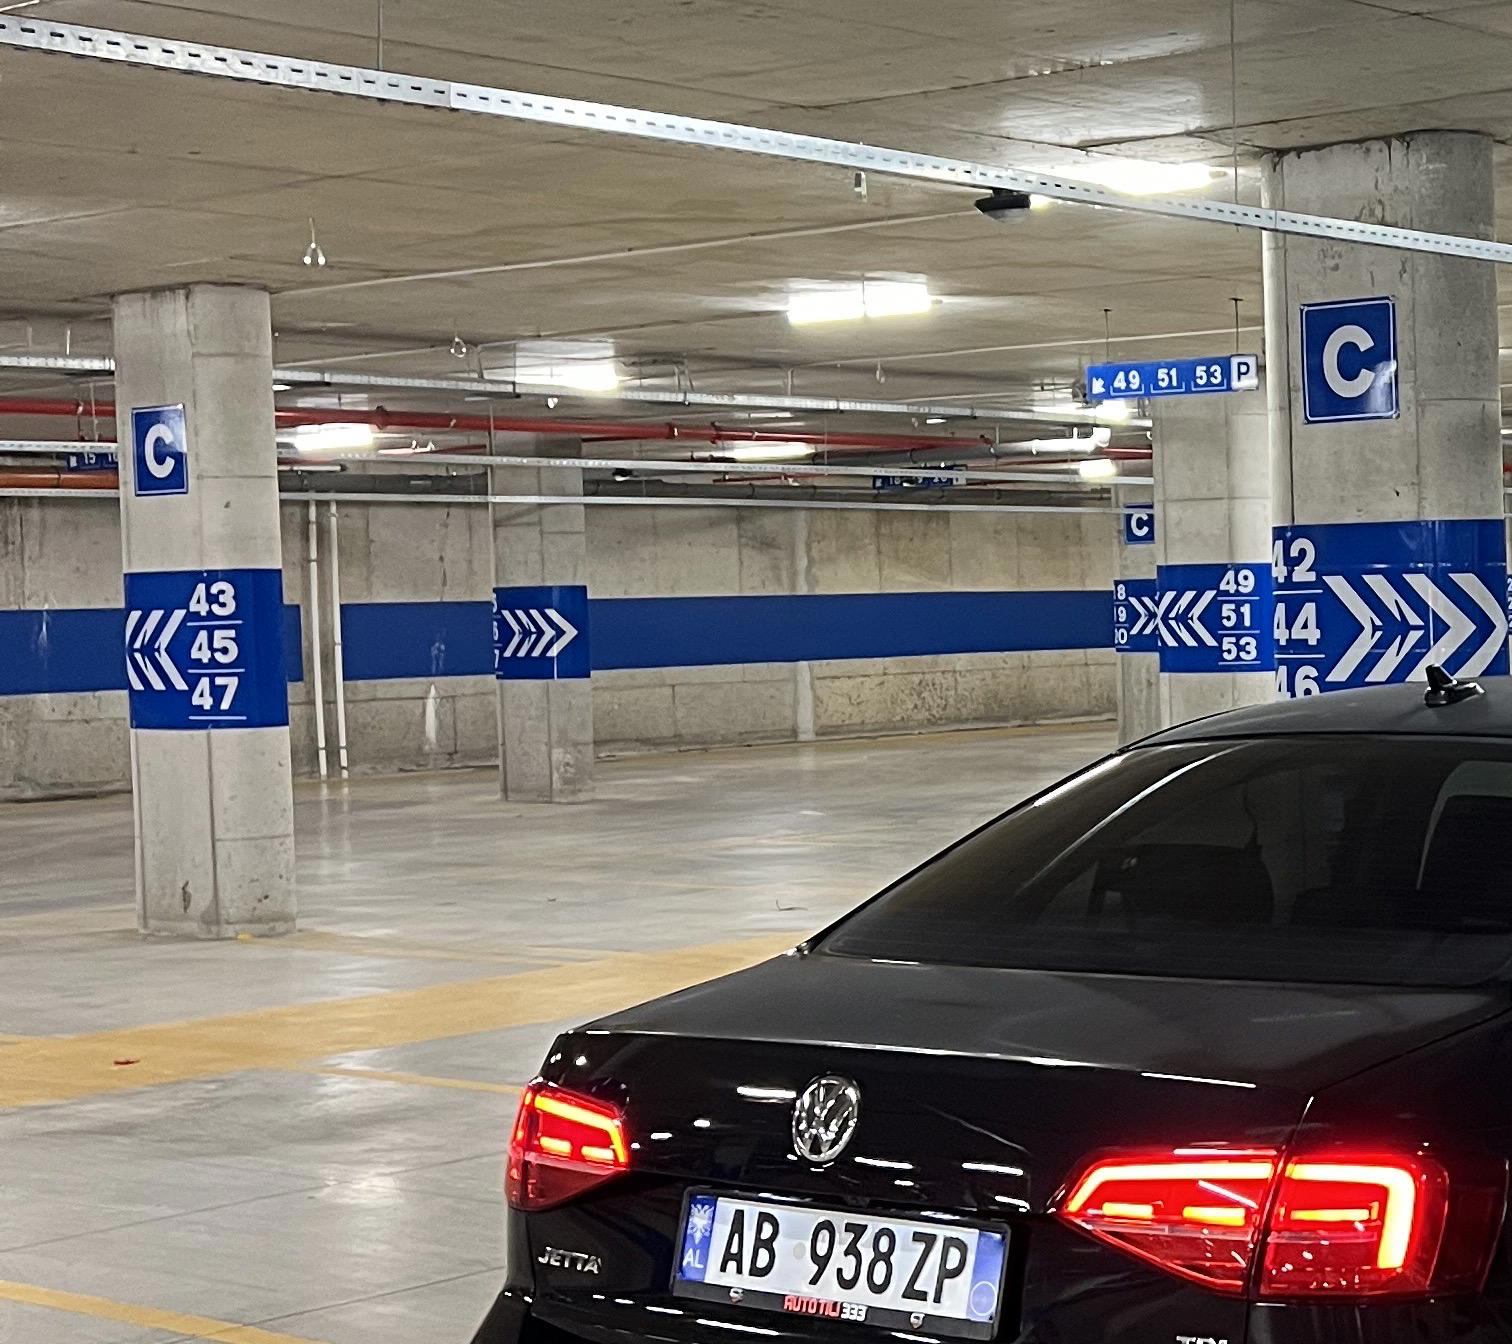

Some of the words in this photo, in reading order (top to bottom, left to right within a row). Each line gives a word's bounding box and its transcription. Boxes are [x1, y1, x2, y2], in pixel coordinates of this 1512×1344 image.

[1113, 370, 1141, 391] 49
[1157, 367, 1178, 388] 51
[1195, 364, 1222, 385] 53
[1237, 361, 1250, 382] P
[1323, 324, 1376, 398] C
[144, 423, 175, 478] C
[1130, 512, 1149, 537] C
[1272, 537, 1317, 583] 42
[189, 581, 236, 616] 43
[1219, 569, 1255, 594] 49
[1221, 603, 1251, 627] 51
[1273, 602, 1321, 646] 44
[190, 629, 239, 664] 45
[1222, 636, 1257, 661] 53
[191, 676, 239, 710] 47
[1275, 665, 1320, 699] 46
[538, 1247, 602, 1274] JETTA
[682, 1248, 704, 1269] AL
[719, 1209, 780, 1278] AB
[808, 1218, 897, 1294] 938
[901, 1231, 969, 1304] ZP
